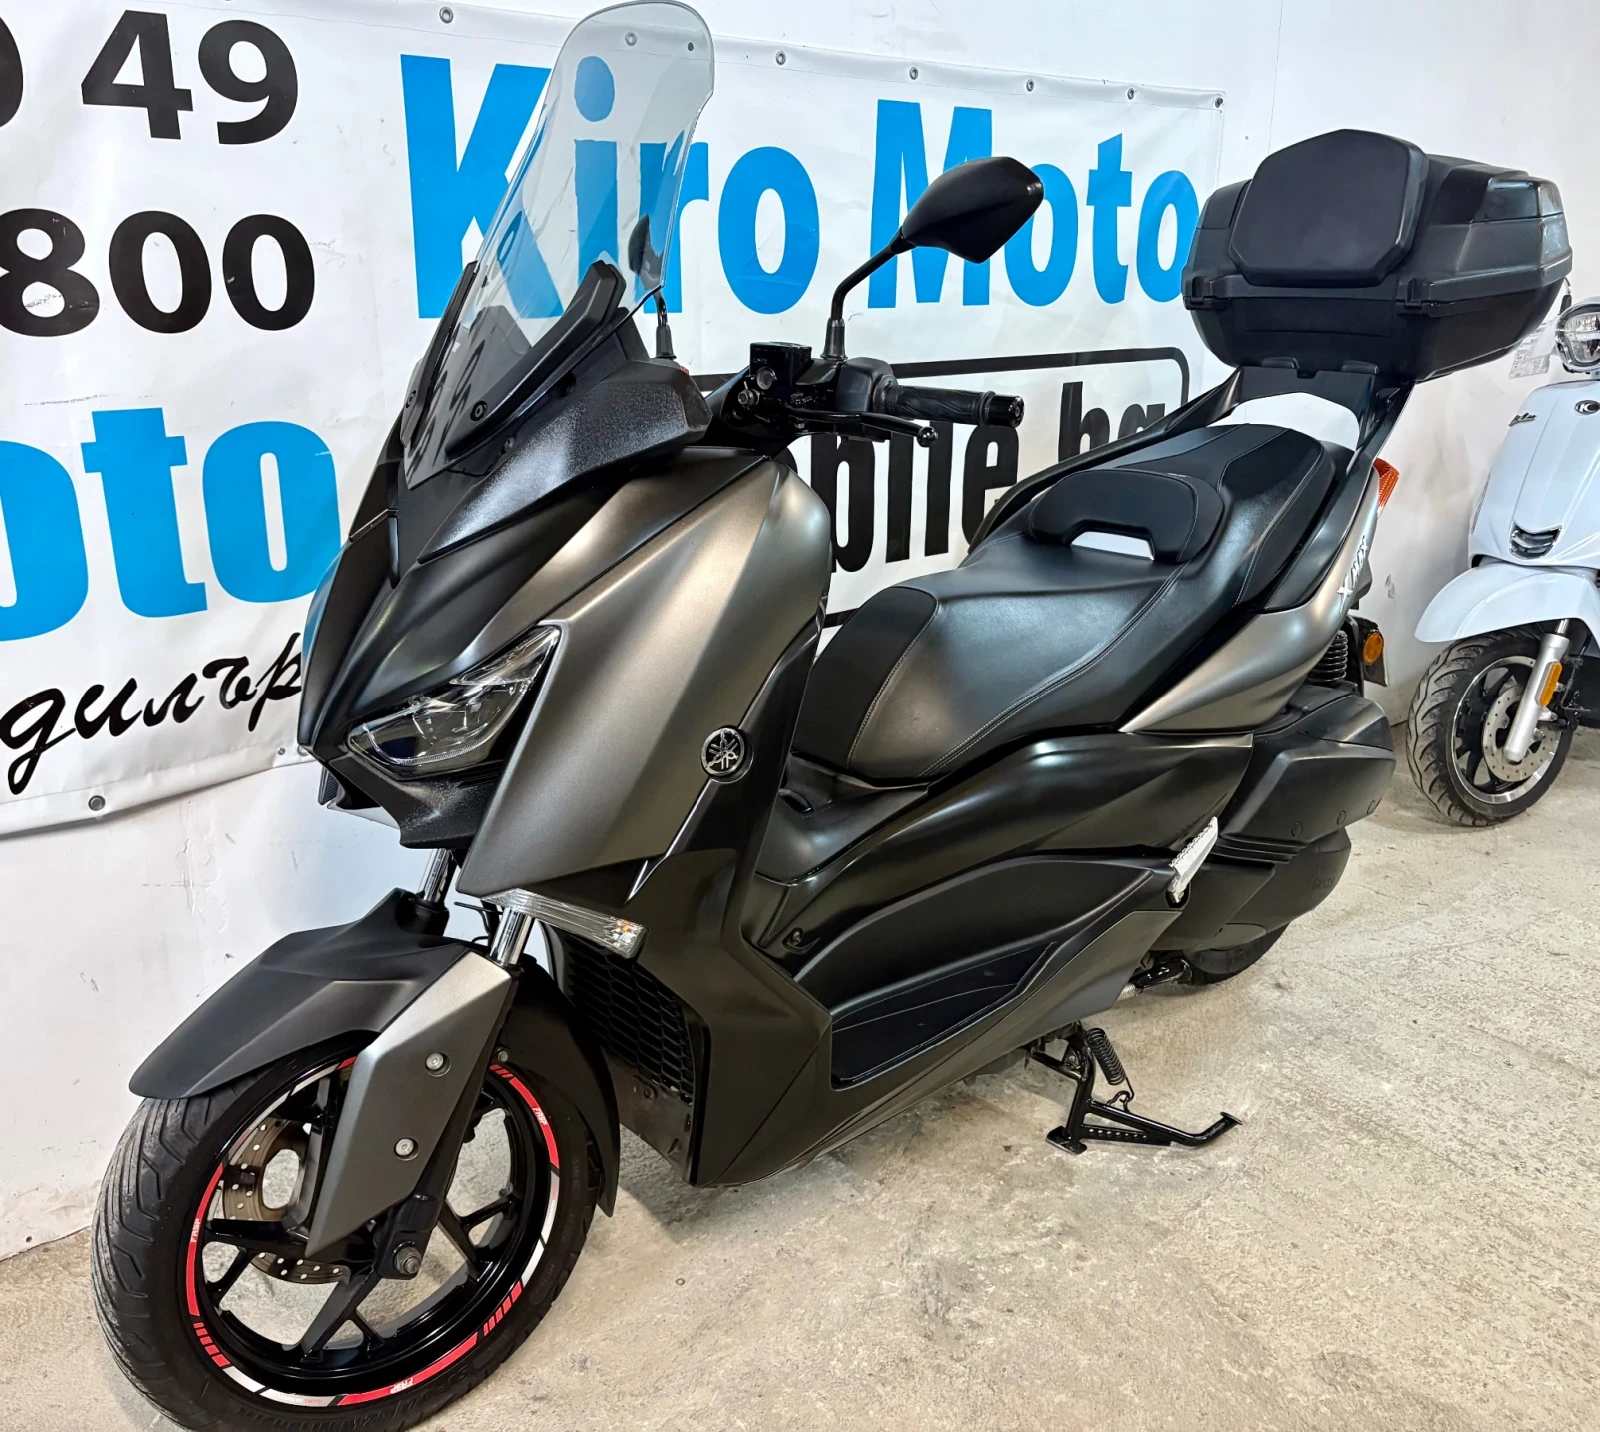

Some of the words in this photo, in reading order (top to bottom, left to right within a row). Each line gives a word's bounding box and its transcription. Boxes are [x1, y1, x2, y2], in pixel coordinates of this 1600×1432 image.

[81, 9, 299, 145] 49
[400, 53, 821, 320] Kiro
[867, 99, 1201, 309] Moto
